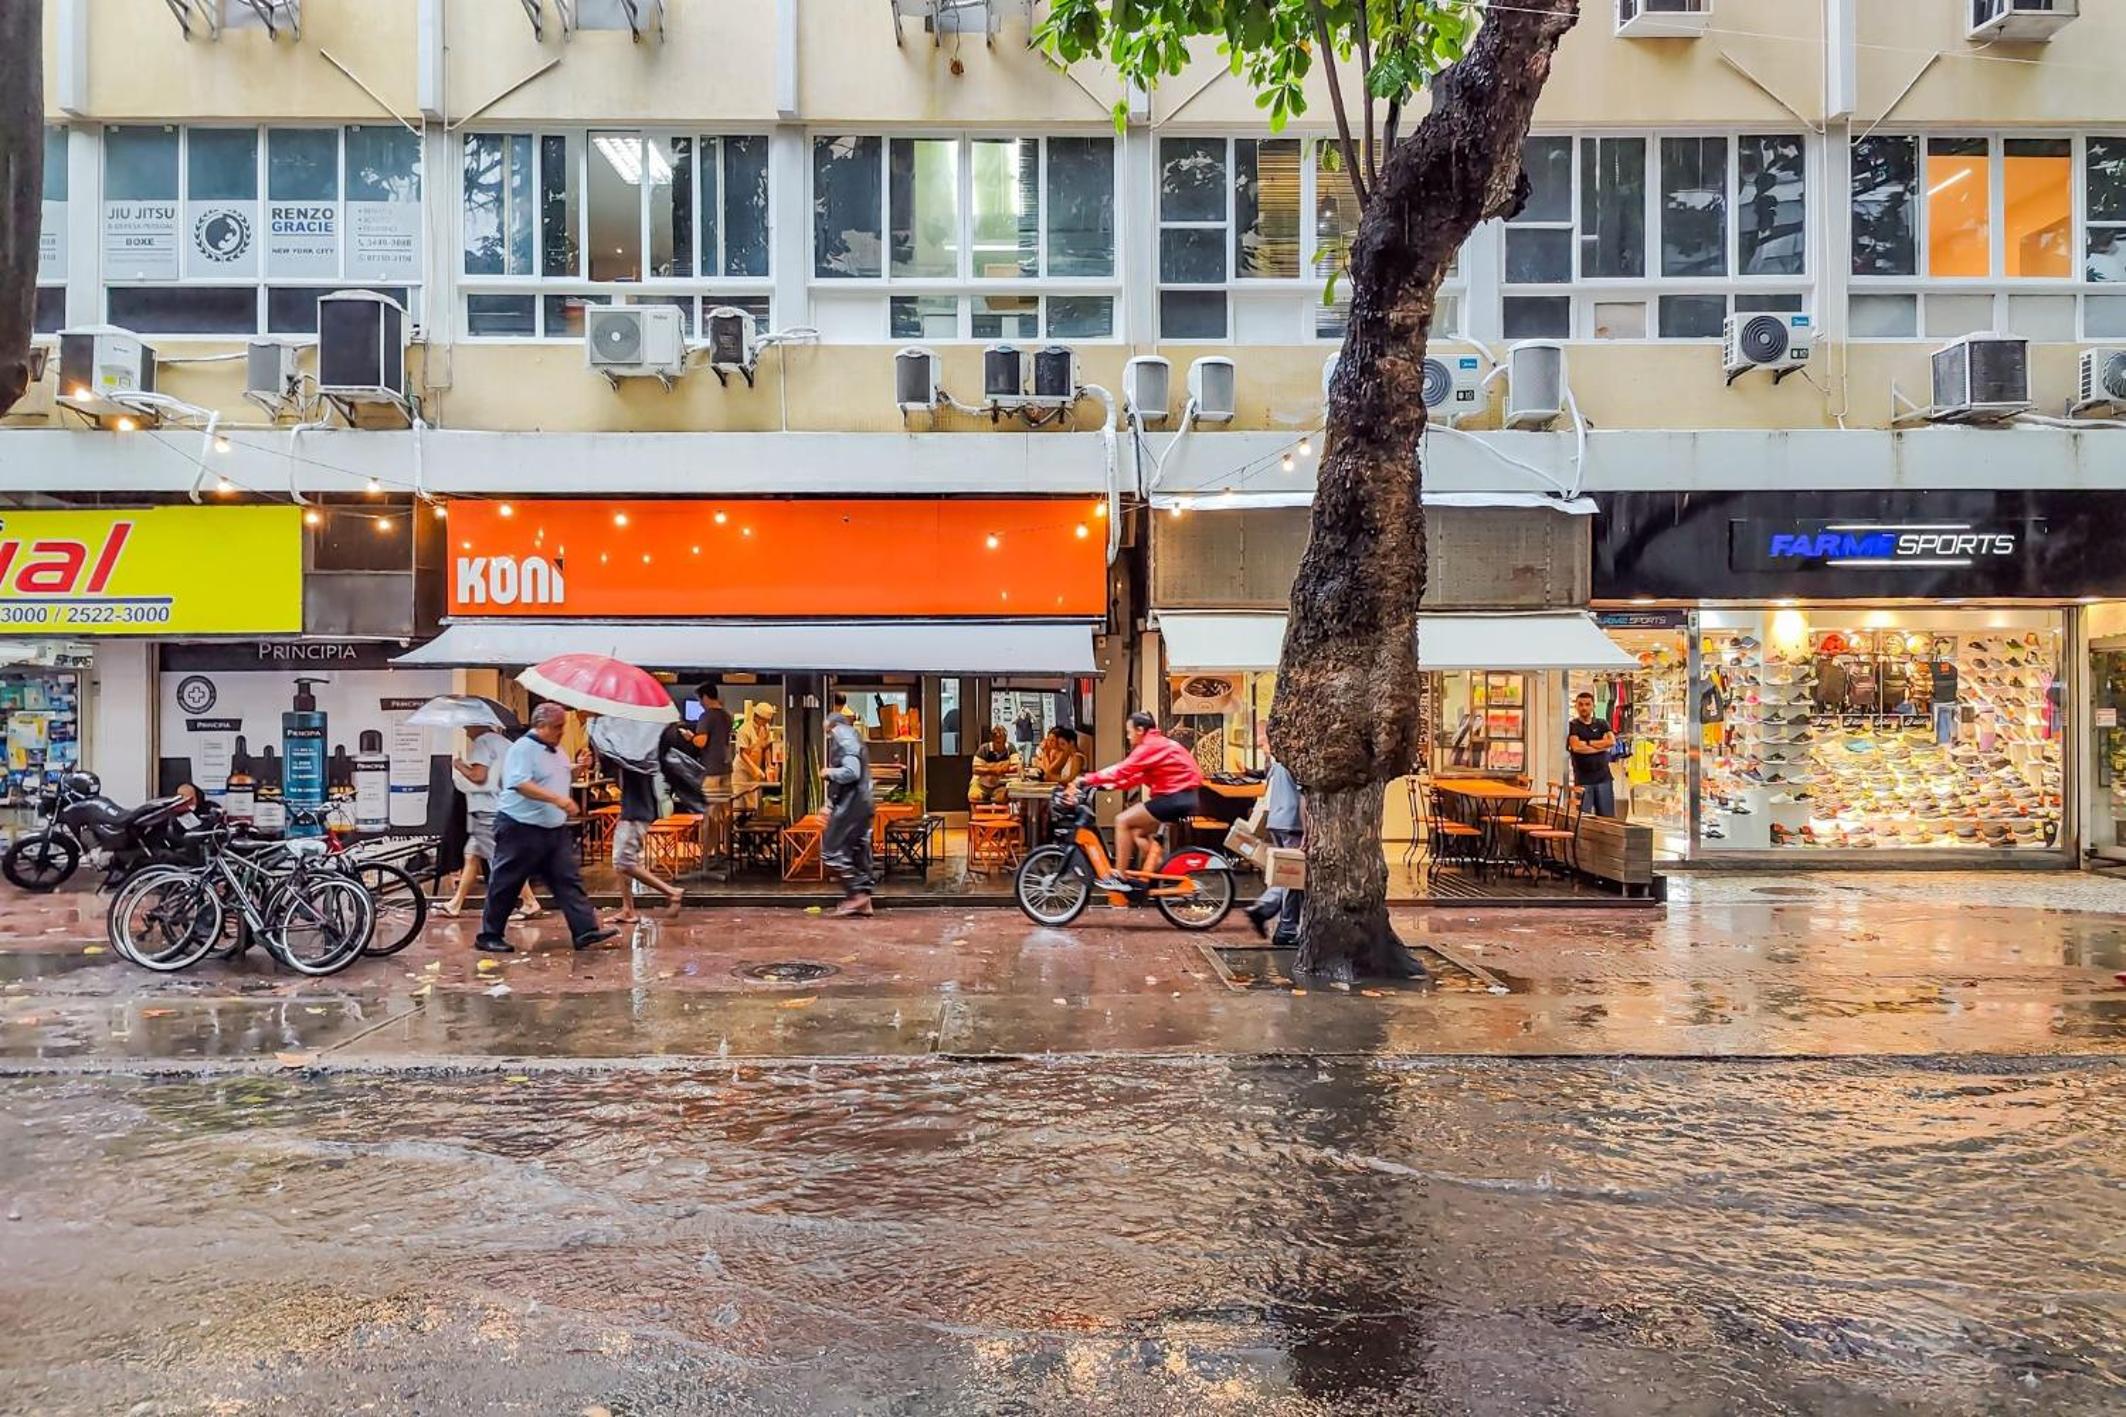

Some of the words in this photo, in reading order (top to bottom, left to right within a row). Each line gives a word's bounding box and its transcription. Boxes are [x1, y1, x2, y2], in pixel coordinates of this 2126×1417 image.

[107, 207, 130, 219] JIU
[135, 207, 175, 219] JITSU
[272, 207, 334, 219] RENZO
[272, 221, 334, 232] GRACIE
[316, 247, 334, 255] CITY
[1897, 534, 2015, 555] SPORTS
[0, 607, 47, 623] 3000
[67, 606, 169, 623] 2522-3000
[259, 642, 357, 659] PRINCIPIA
